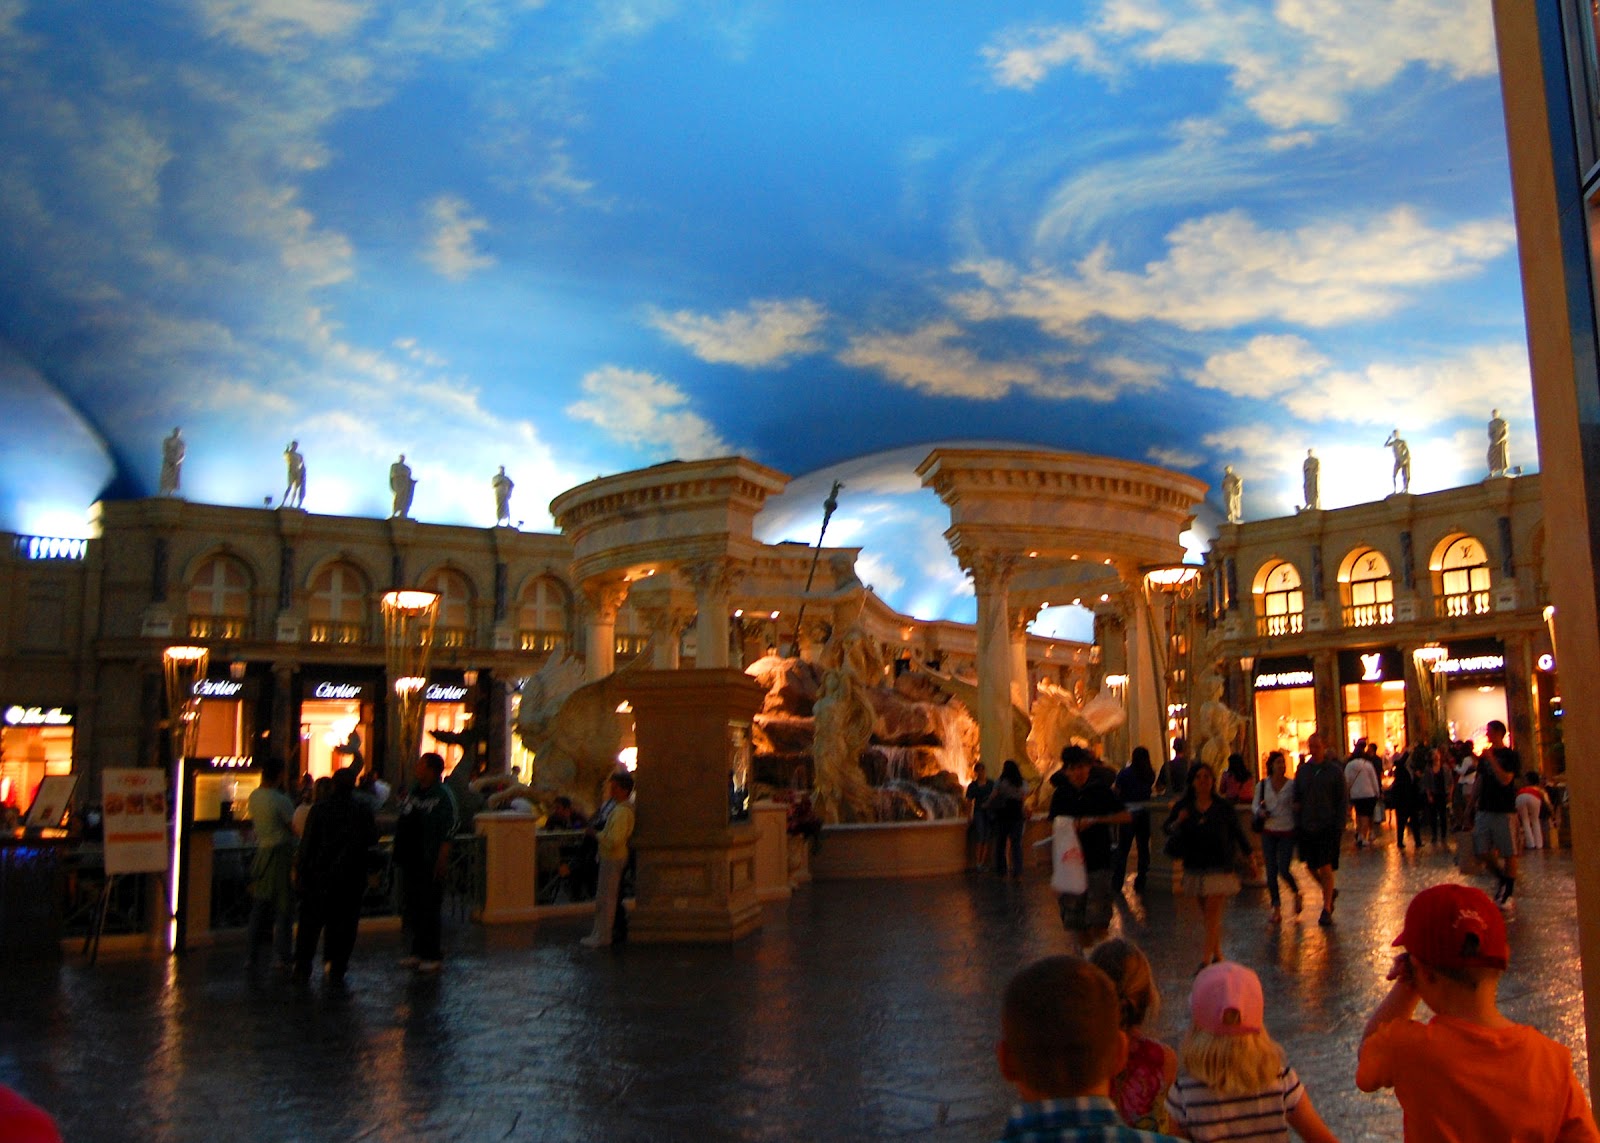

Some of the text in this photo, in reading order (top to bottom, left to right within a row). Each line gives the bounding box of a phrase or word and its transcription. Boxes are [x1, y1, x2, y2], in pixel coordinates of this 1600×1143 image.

[1360, 653, 1381, 680] LV
[193, 679, 242, 695] Cartier
[316, 681, 362, 698] Cartier
[426, 683, 468, 699] Cartier
